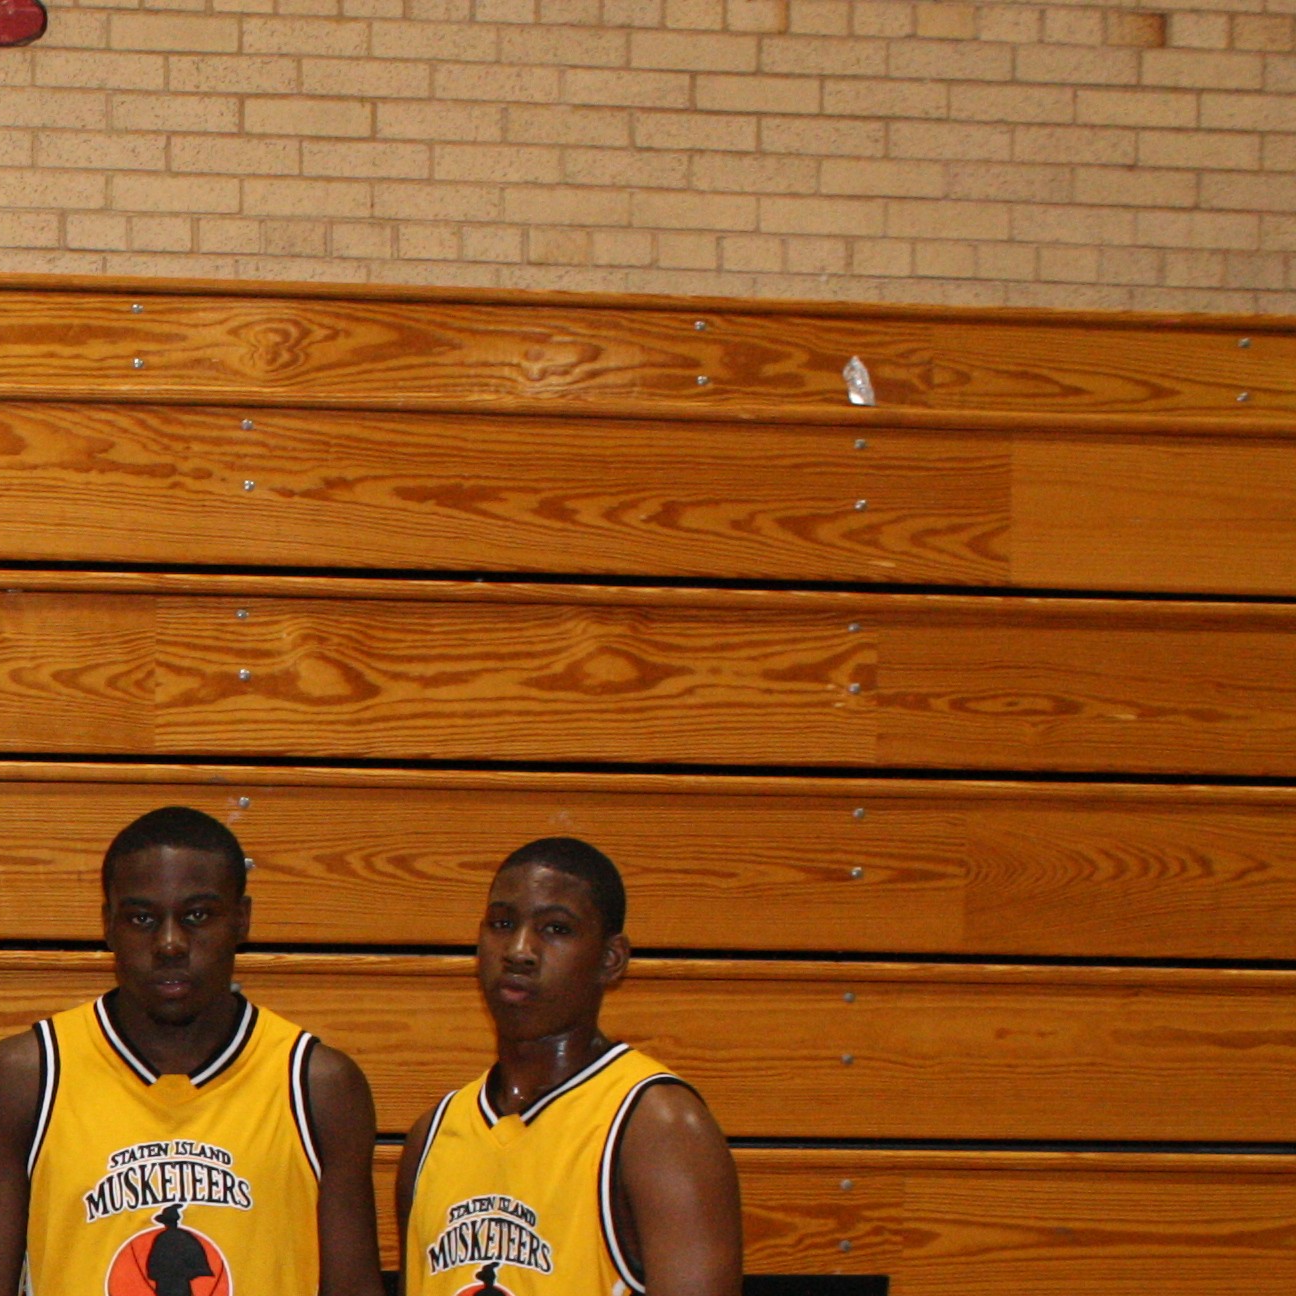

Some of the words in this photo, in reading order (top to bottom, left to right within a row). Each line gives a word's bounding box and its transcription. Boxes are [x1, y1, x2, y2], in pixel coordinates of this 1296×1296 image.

[110, 1143, 170, 1168] STATEN
[175, 1141, 231, 1165] ISLAND
[85, 1161, 251, 1220] MUSKETEERS
[449, 1196, 496, 1224] STATEN
[499, 1196, 536, 1227] ISLAND
[428, 1217, 551, 1273] MUSKETEERS
